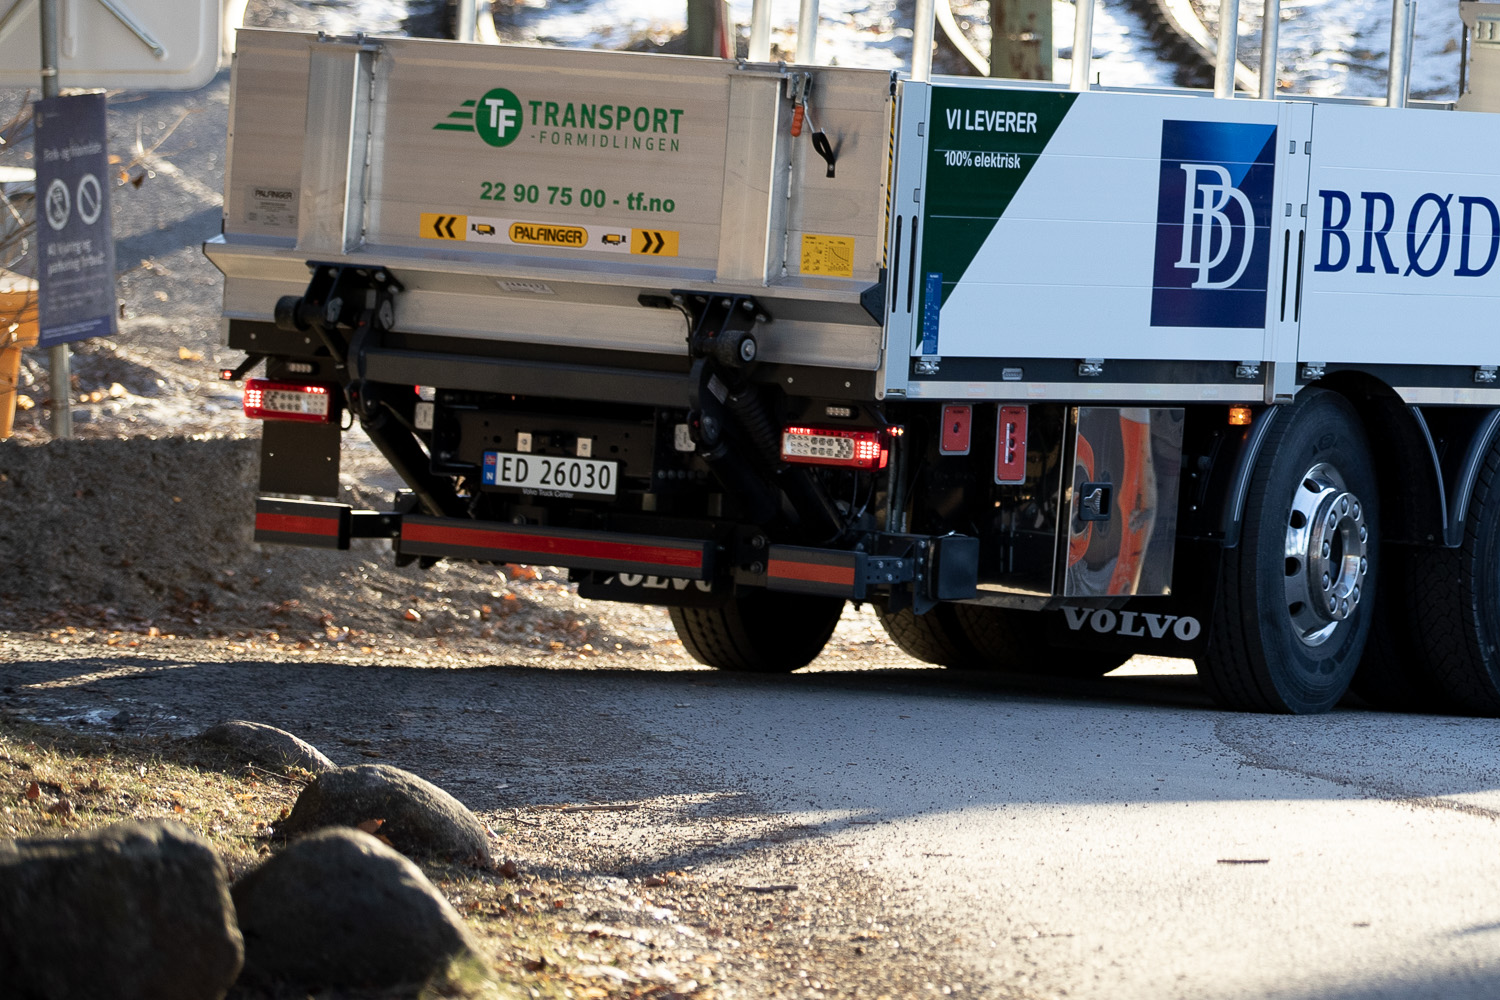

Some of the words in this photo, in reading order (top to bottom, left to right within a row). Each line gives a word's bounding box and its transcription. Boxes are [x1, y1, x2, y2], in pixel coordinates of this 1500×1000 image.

[485, 98, 517, 138] TF
[528, 100, 685, 134] TRANSPORT
[946, 108, 961, 131] VI
[965, 108, 1038, 134] LEVERER
[944, 150, 972, 167] 100%
[974, 151, 1021, 169] elektrisk
[479, 182, 506, 201] 22
[513, 184, 540, 204] 90
[547, 186, 573, 206] 75
[580, 188, 606, 209] 00
[626, 192, 675, 213] tf.no
[513, 225, 583, 244] PALFINGER
[486, 471, 494, 480] N
[501, 457, 529, 483] ED
[539, 459, 611, 490] 26030
[1060, 605, 1201, 641] VOLVO
